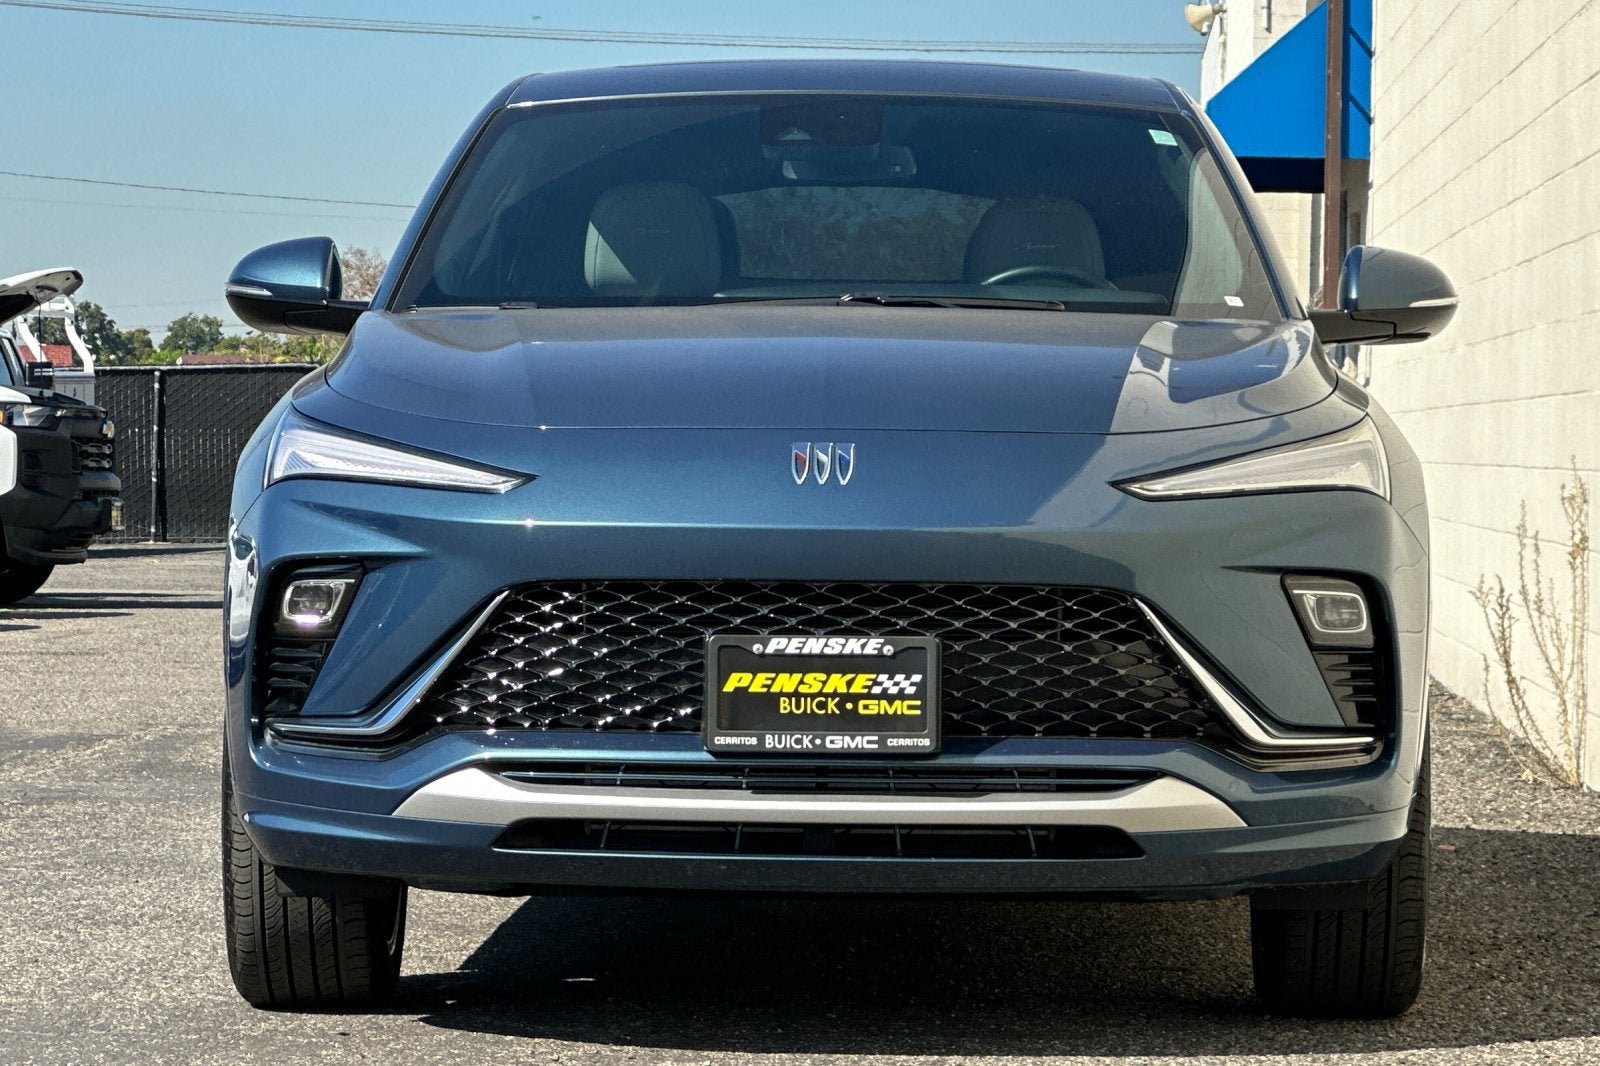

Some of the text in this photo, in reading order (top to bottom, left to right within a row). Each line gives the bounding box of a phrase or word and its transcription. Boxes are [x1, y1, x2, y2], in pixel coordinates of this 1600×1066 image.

[765, 637, 885, 655] PENSKE
[722, 673, 877, 693] PENSKE
[779, 697, 922, 715] BUICK GMC
[714, 736, 758, 745] CERRITOS
[765, 734, 879, 749] BUICK GMC
[887, 738, 931, 747] CERRITOS
